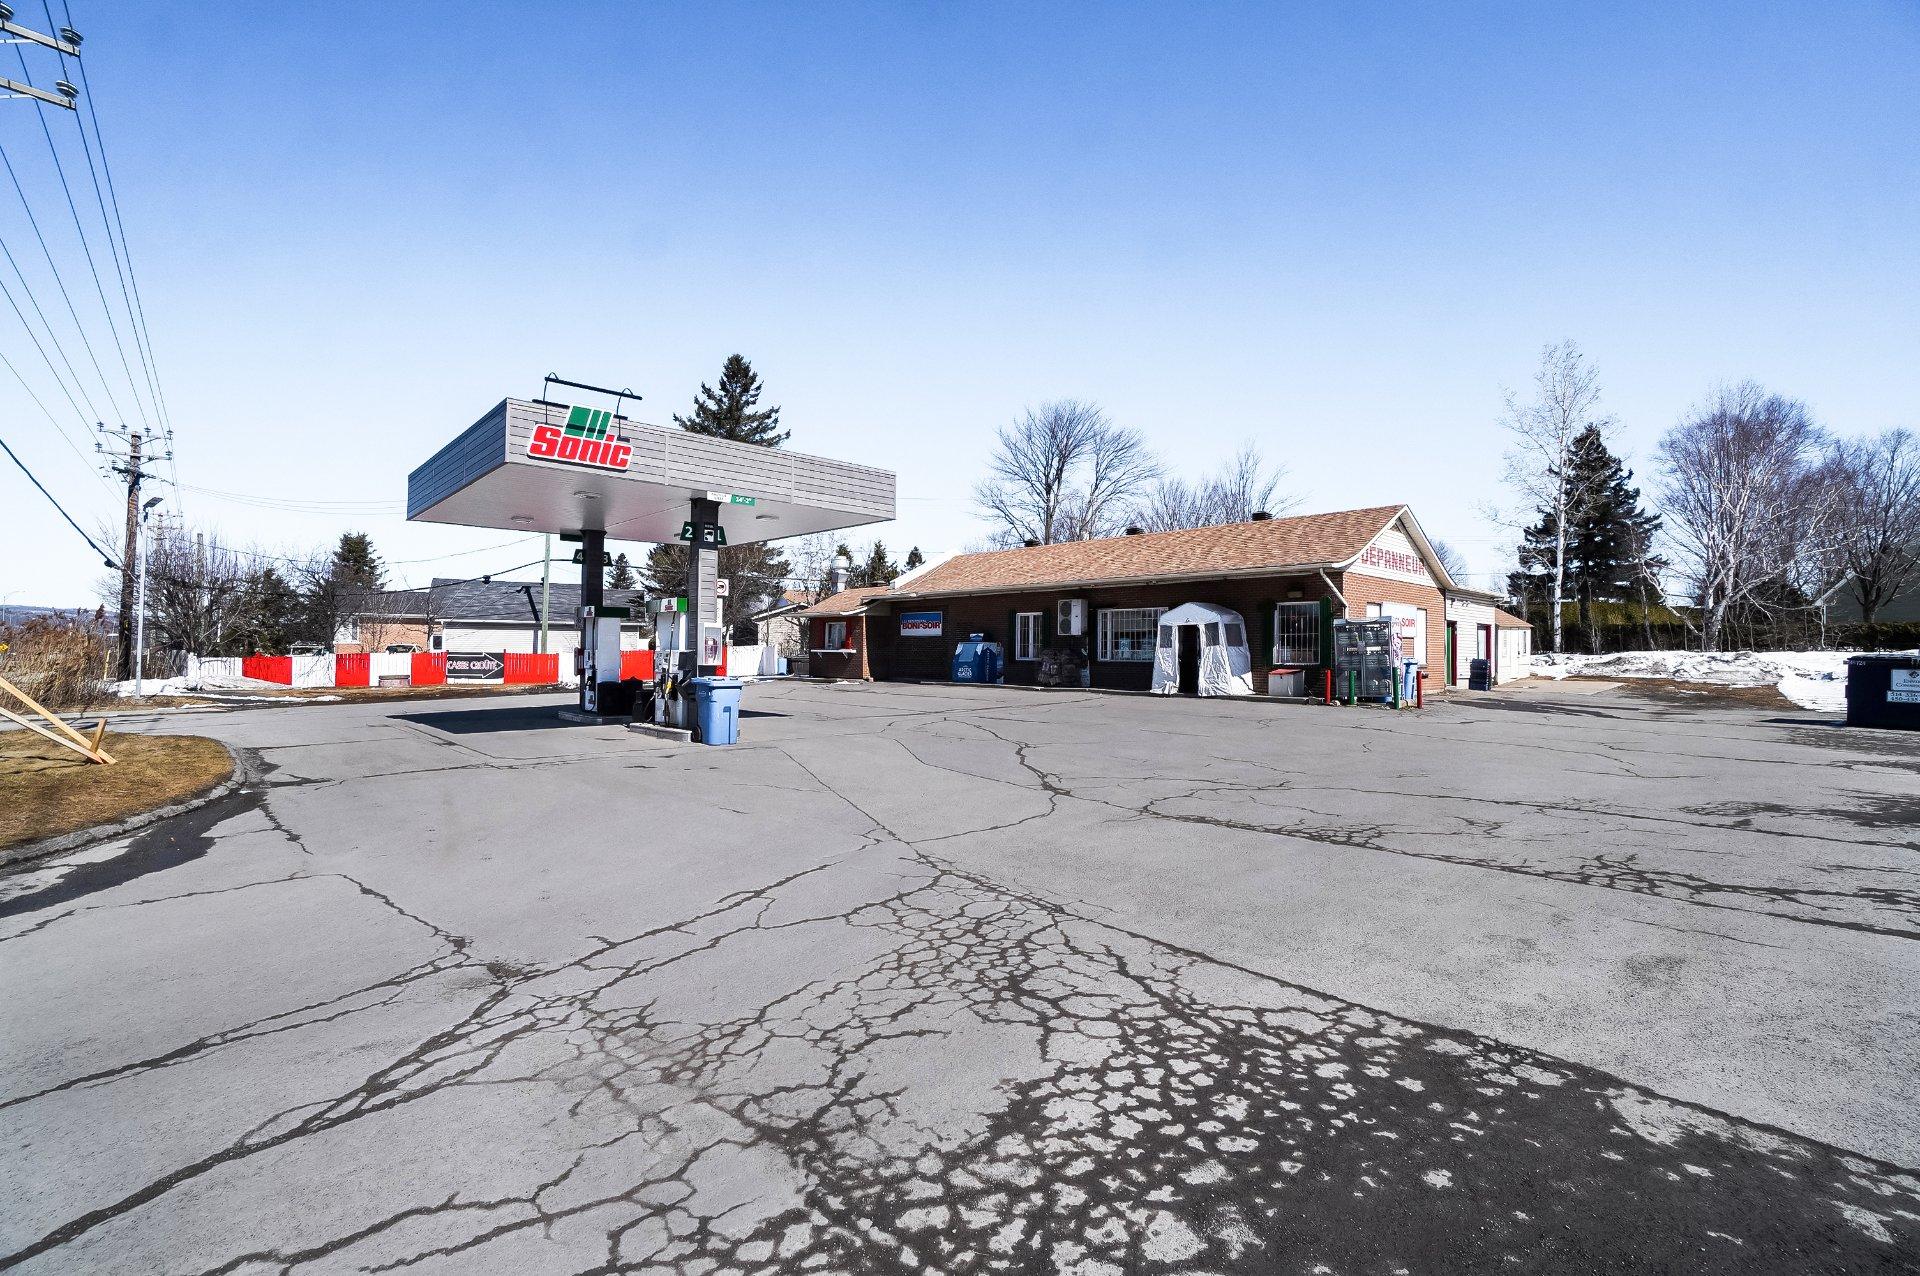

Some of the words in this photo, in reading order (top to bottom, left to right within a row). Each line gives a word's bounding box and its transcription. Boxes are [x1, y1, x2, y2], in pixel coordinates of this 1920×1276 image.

[529, 425, 632, 468] Sonic
[685, 526, 693, 538] 2
[576, 552, 584, 562] 4
[603, 554, 609, 564] 3
[1361, 543, 1425, 576] DÉPANNEUR
